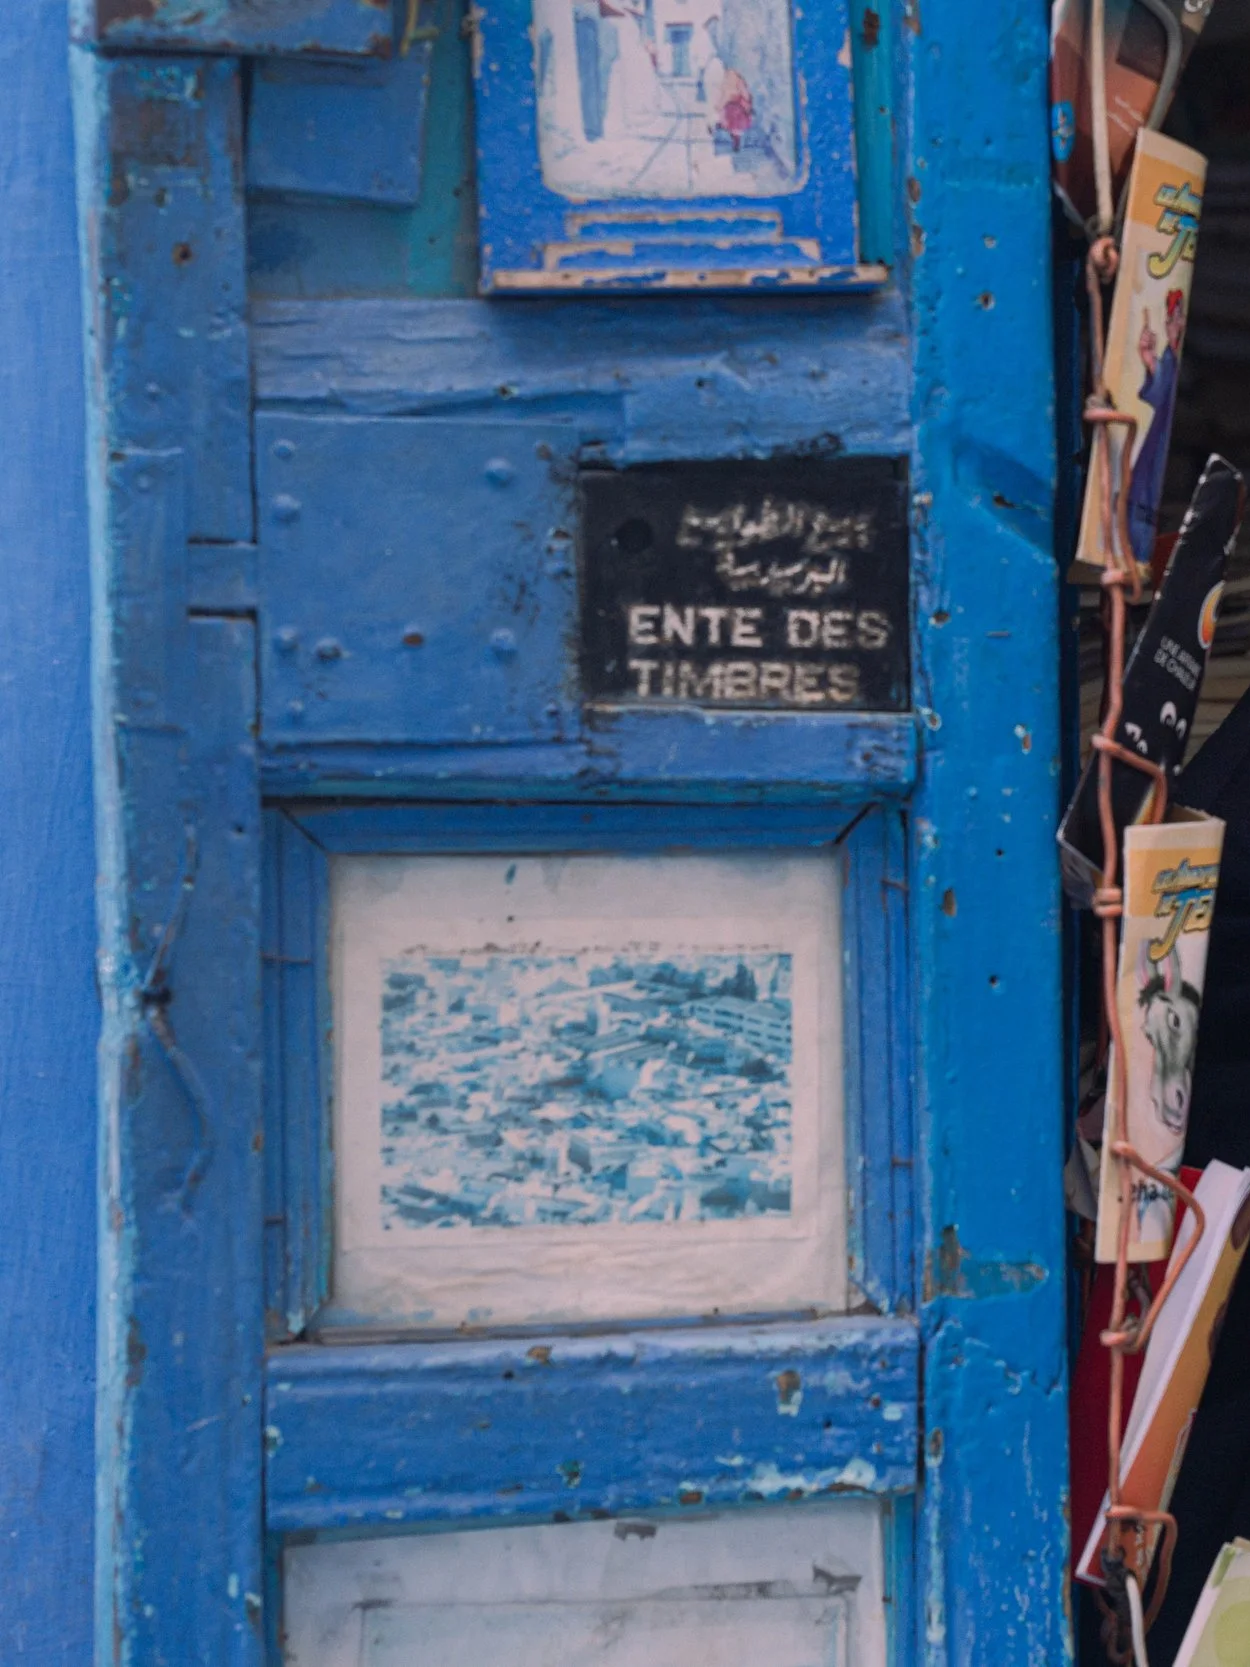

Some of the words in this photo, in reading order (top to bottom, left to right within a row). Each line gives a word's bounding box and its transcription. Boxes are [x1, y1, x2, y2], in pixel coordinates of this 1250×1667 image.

[628, 603, 763, 649] ENTE
[787, 608, 893, 650] DES
[628, 659, 861, 704] TIMBRES
